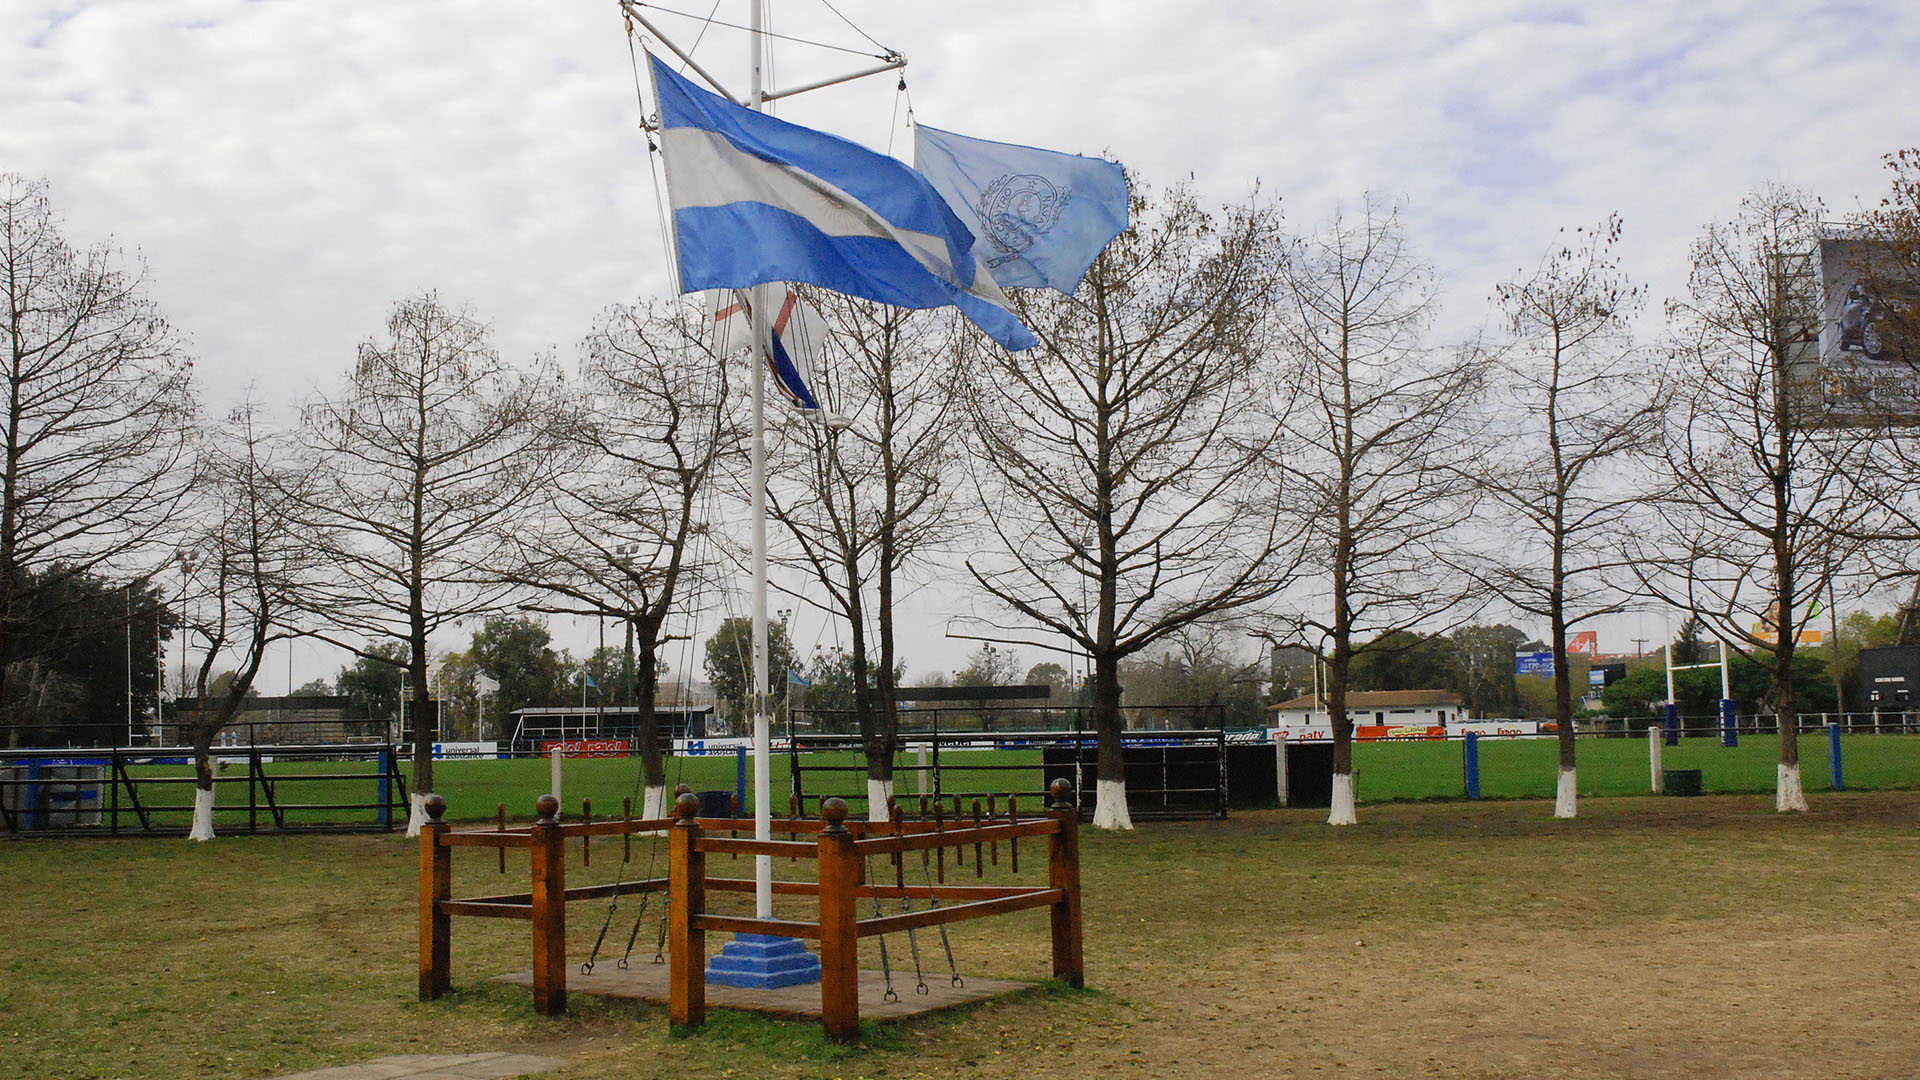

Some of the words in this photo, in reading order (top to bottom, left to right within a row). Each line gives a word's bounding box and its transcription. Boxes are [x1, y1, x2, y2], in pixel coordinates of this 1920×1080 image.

[994, 187, 1012, 232] CENTRO
[1037, 195, 1052, 225] NAVA
[445, 746, 480, 754] universal
